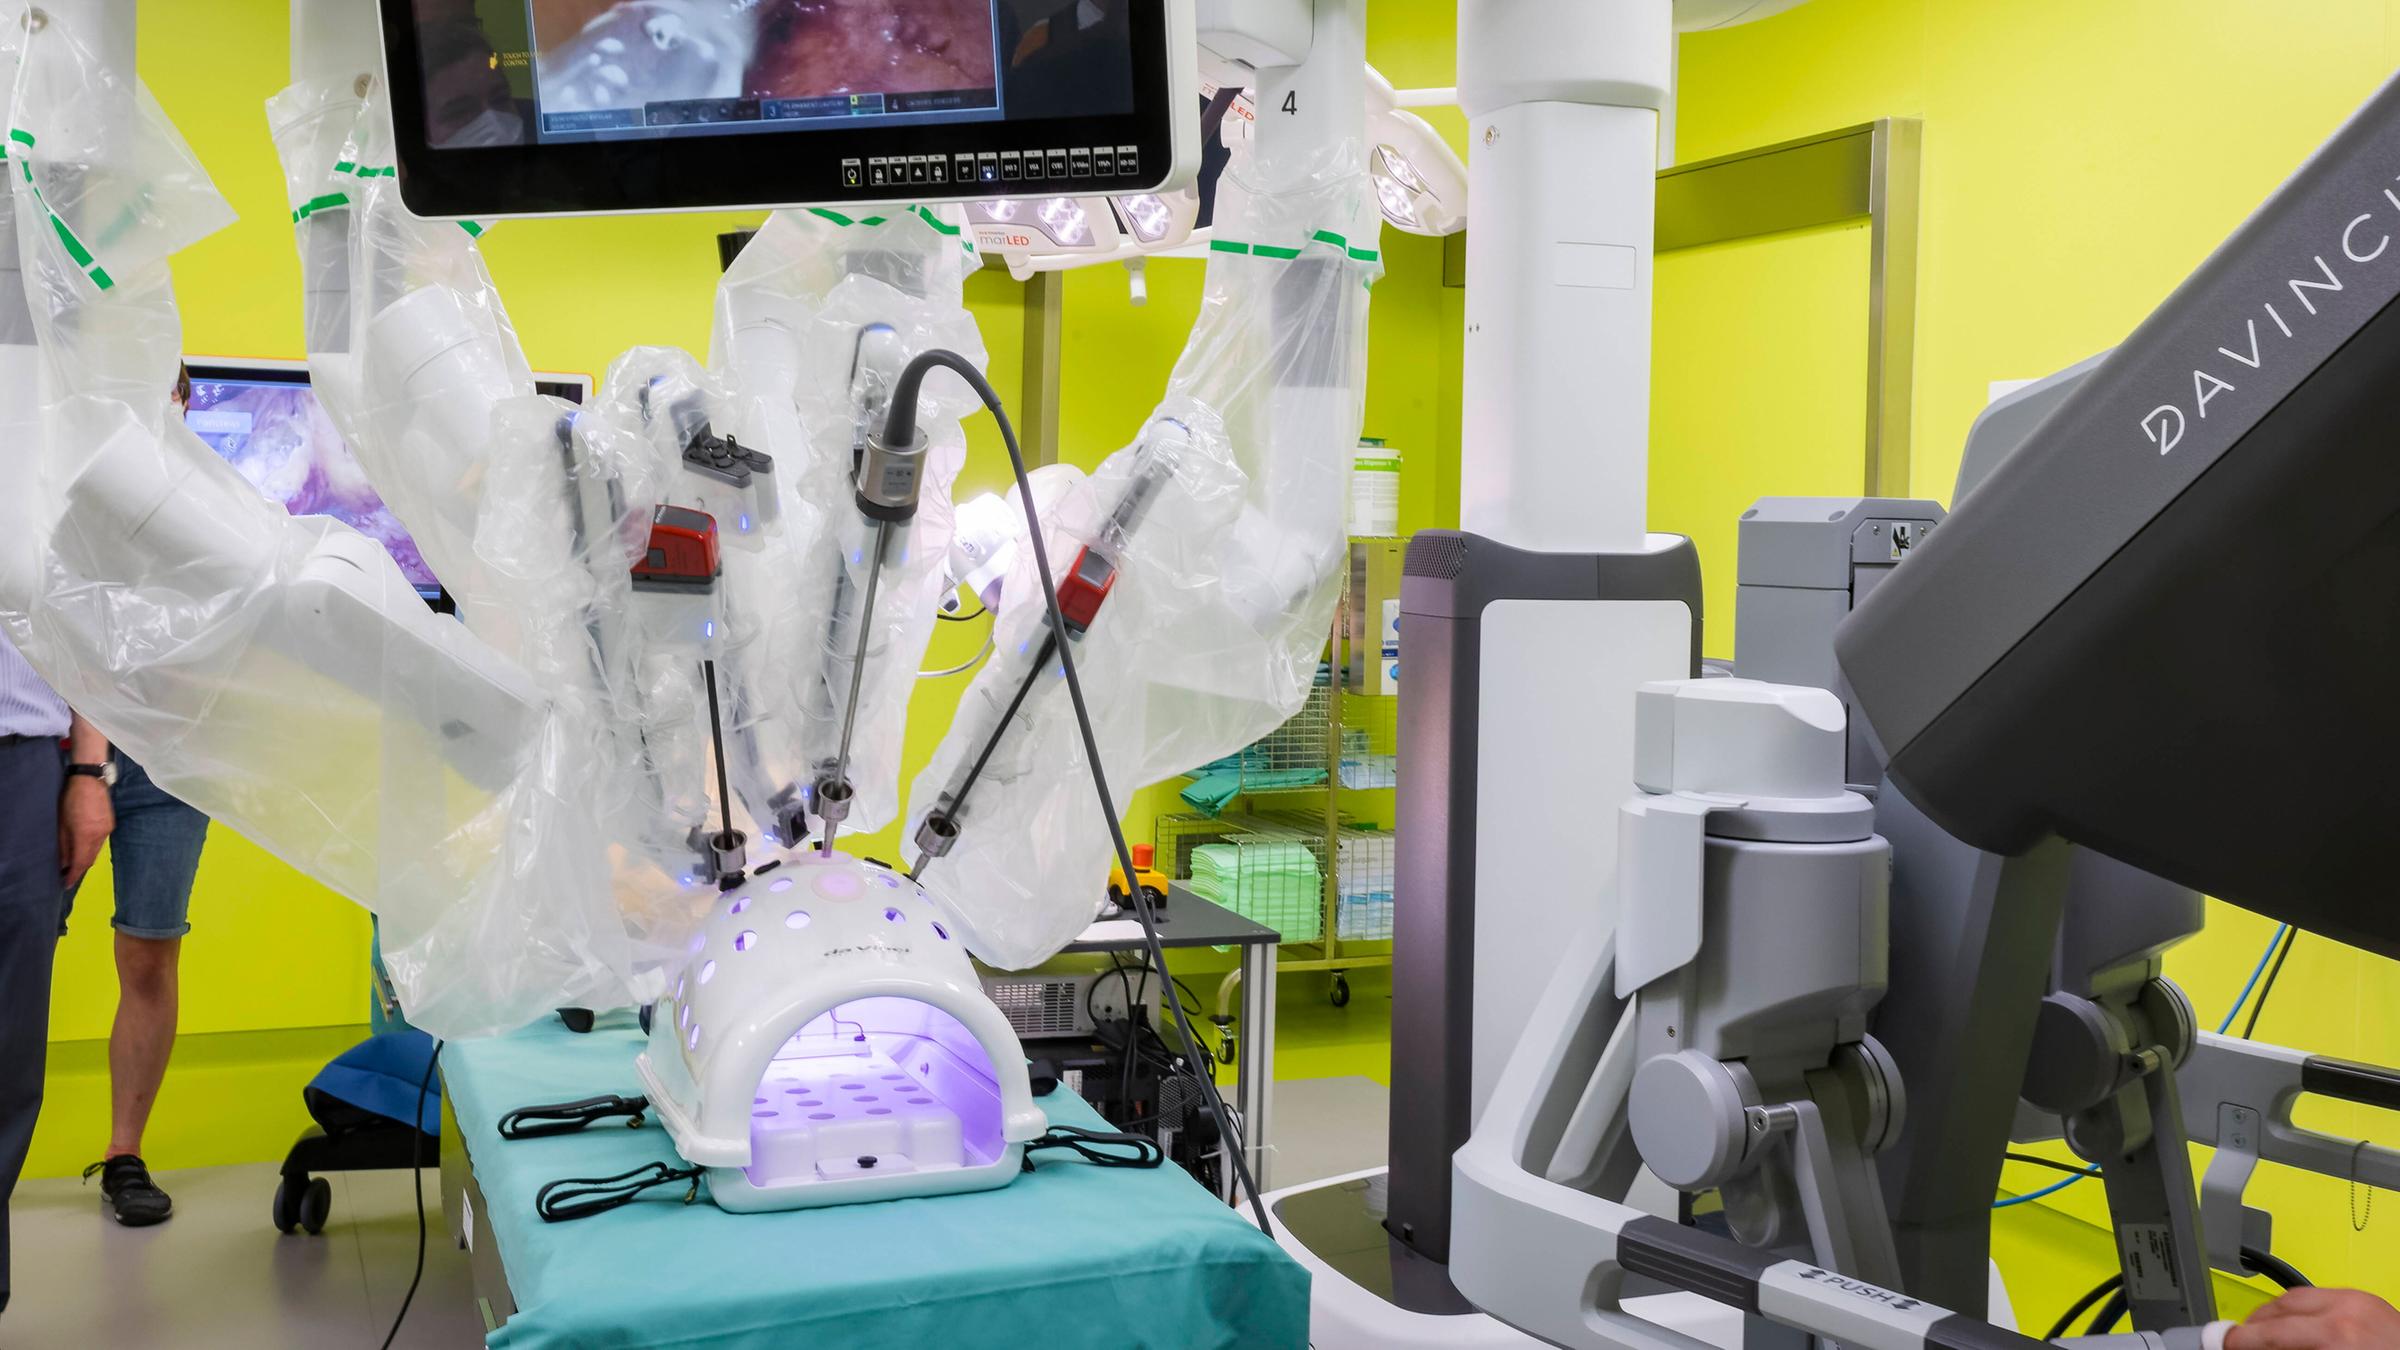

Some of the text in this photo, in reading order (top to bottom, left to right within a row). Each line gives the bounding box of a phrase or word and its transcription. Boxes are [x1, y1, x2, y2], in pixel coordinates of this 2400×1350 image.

[769, 106, 776, 117] 3
[1282, 90, 1297, 115] 4
[980, 235, 1030, 246] marLED
[1823, 1276, 1895, 1302] PUSH
